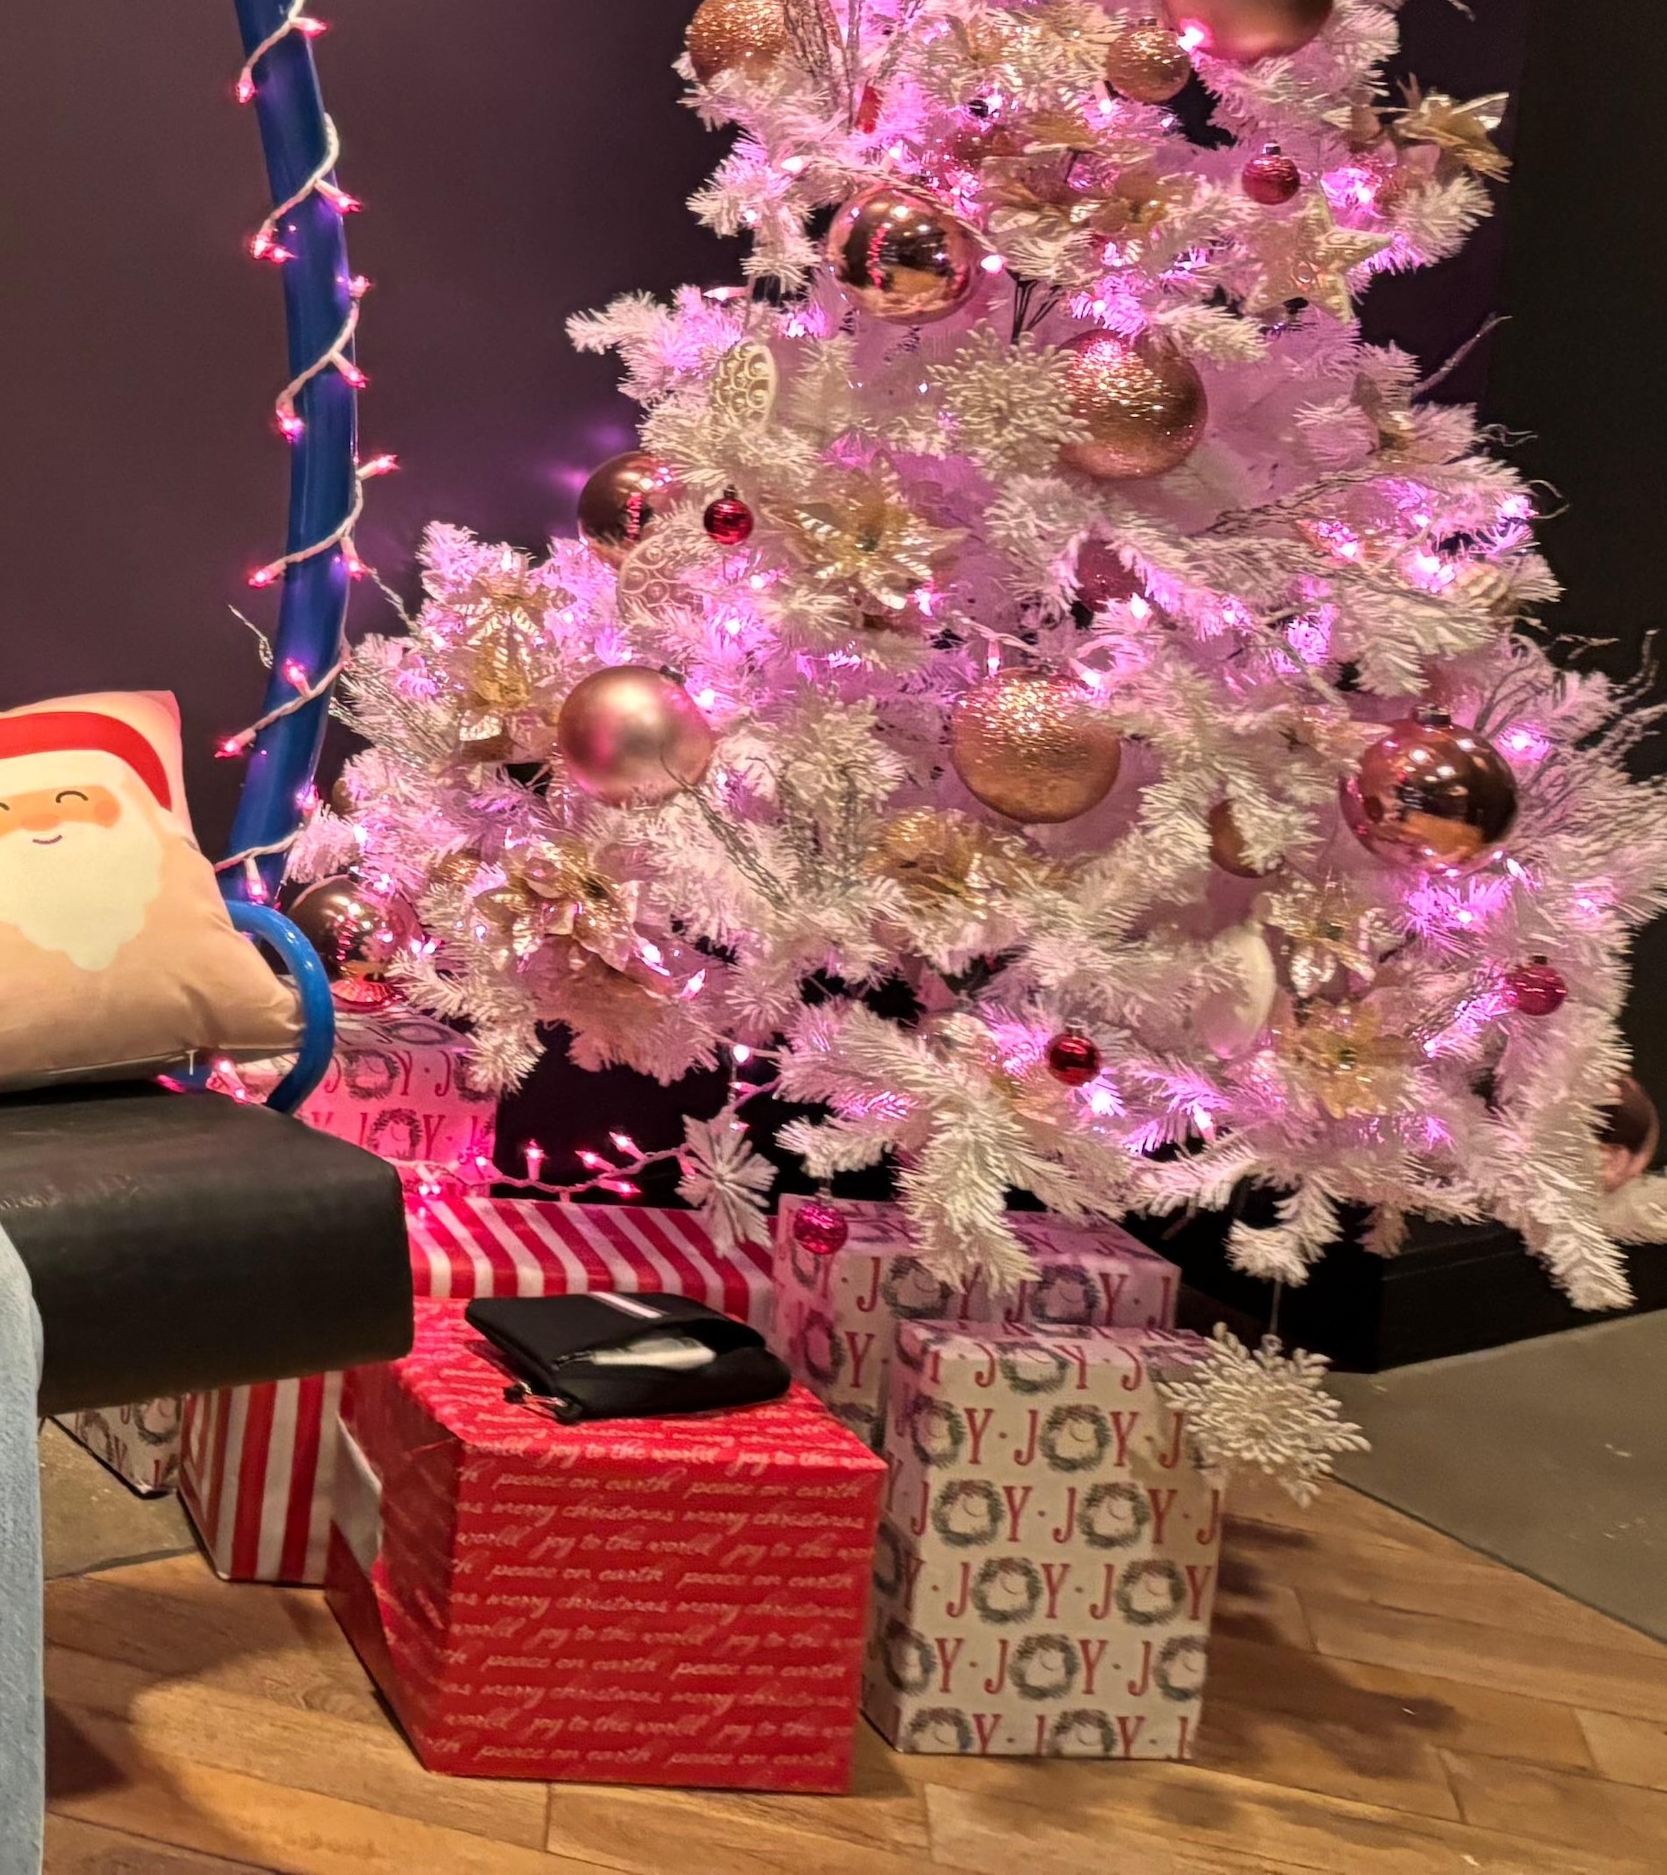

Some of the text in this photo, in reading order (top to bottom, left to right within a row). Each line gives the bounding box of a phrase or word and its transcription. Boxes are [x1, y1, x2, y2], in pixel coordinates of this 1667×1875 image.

[534, 1443, 582, 1469] joy
[584, 1443, 608, 1460] to
[609, 1438, 647, 1460] the
[651, 1445, 721, 1465] world
[724, 1450, 770, 1477] joy
[773, 1450, 796, 1466] to
[798, 1447, 837, 1467] the
[491, 1466, 877, 1500] peace on earth peace on earth
[491, 1502, 558, 1527] merry
[561, 1495, 675, 1522] christmas
[681, 1511, 750, 1536] merry
[752, 1501, 866, 1530] christmas
[454, 1525, 532, 1547] world
[527, 1534, 577, 1561] joy
[579, 1532, 602, 1551] to
[604, 1525, 647, 1551] the
[646, 1532, 724, 1557] world
[718, 1544, 767, 1567] joy
[770, 1541, 792, 1558] to
[794, 1532, 839, 1559] the
[485, 1557, 871, 1591] peace on earth peace on earth
[485, 1593, 552, 1619] merry
[555, 1583, 668, 1612] christmas
[675, 1601, 740, 1627] merry
[743, 1592, 857, 1621] christmas
[449, 1616, 527, 1639] world
[521, 1628, 572, 1651] joy
[573, 1624, 596, 1642] to
[598, 1616, 641, 1643] the
[641, 1624, 718, 1646] world
[712, 1635, 761, 1658] joy
[764, 1631, 787, 1648] to
[788, 1623, 832, 1648] the
[479, 1648, 865, 1681] peace on earth peace on earth
[479, 1684, 547, 1709] merry
[548, 1674, 663, 1703] christmas
[669, 1691, 737, 1717] merry
[516, 1717, 566, 1742] joy
[568, 1714, 590, 1732] to
[592, 1707, 636, 1733] the
[634, 1714, 711, 1737] world
[705, 1725, 754, 1747] joy
[755, 1720, 777, 1737] to
[780, 1712, 824, 1739] the
[471, 1745, 547, 1762] peace
[549, 1749, 580, 1761] on
[586, 1738, 671, 1764] earth
[663, 1753, 736, 1770] peace
[738, 1754, 768, 1766] on
